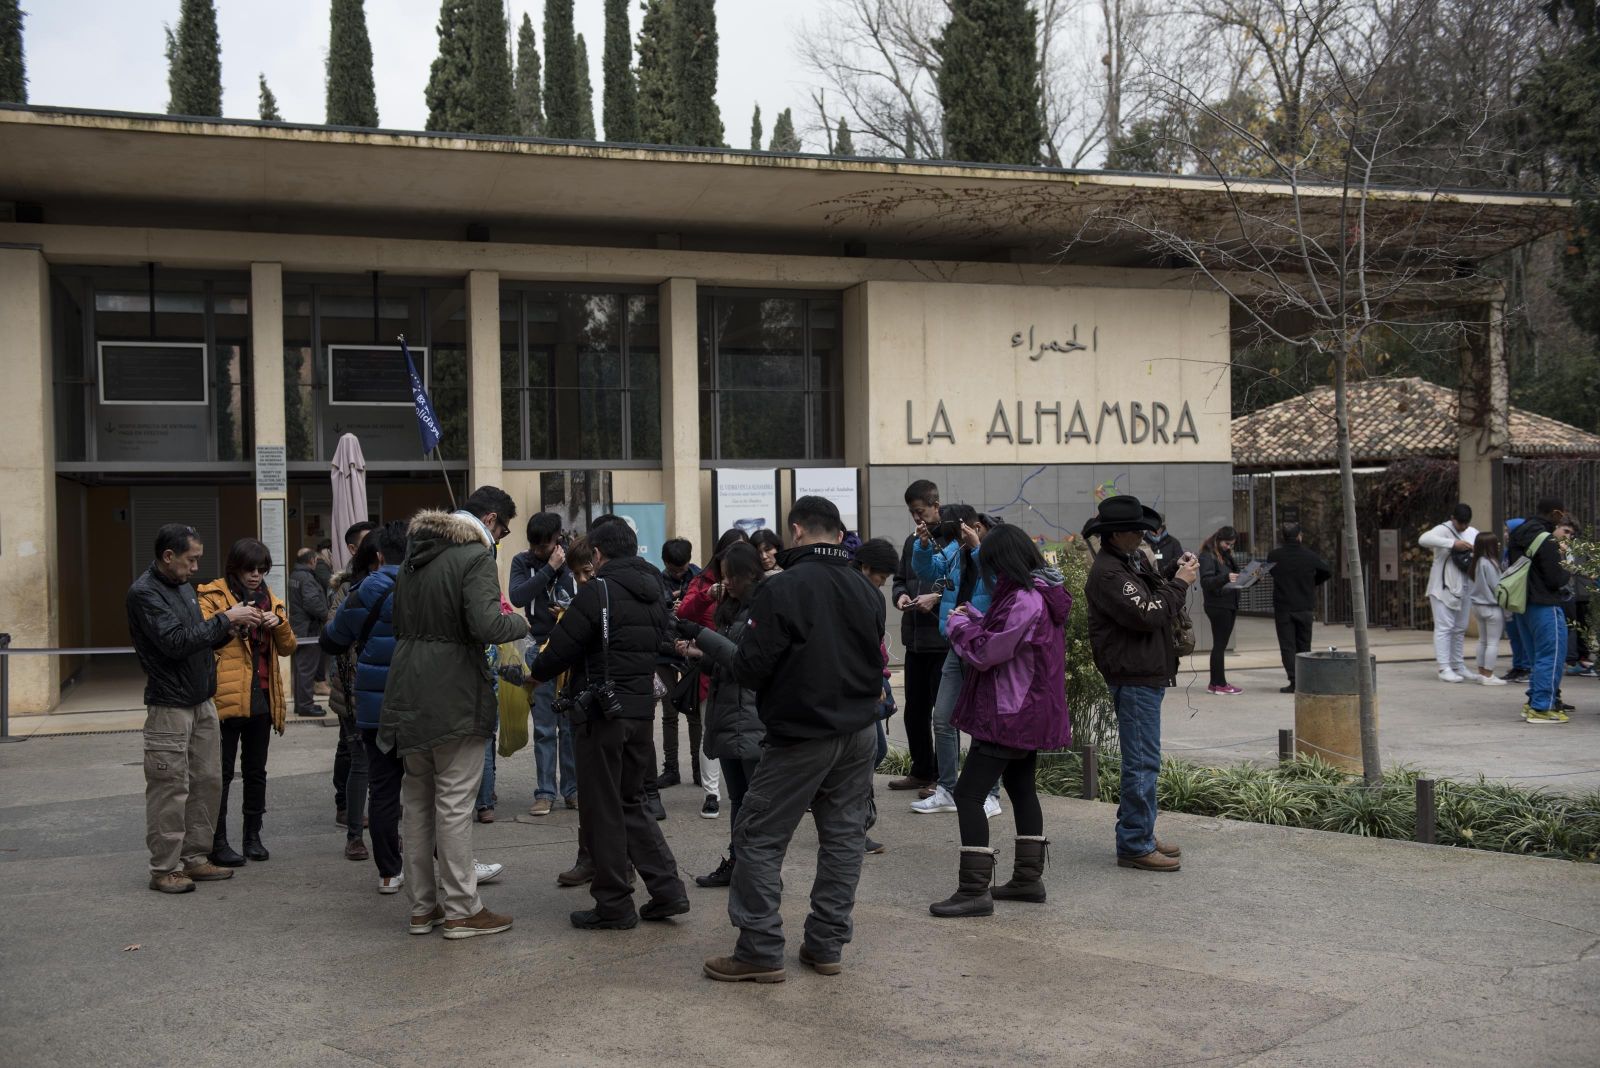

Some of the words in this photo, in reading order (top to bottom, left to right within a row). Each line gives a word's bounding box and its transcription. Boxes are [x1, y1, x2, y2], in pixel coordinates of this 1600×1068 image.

[1010, 323, 1098, 361] الحمراء
[906, 399, 956, 445] LA
[986, 398, 1200, 445] ALHAMBRA
[1130, 595, 1163, 611] AAT
